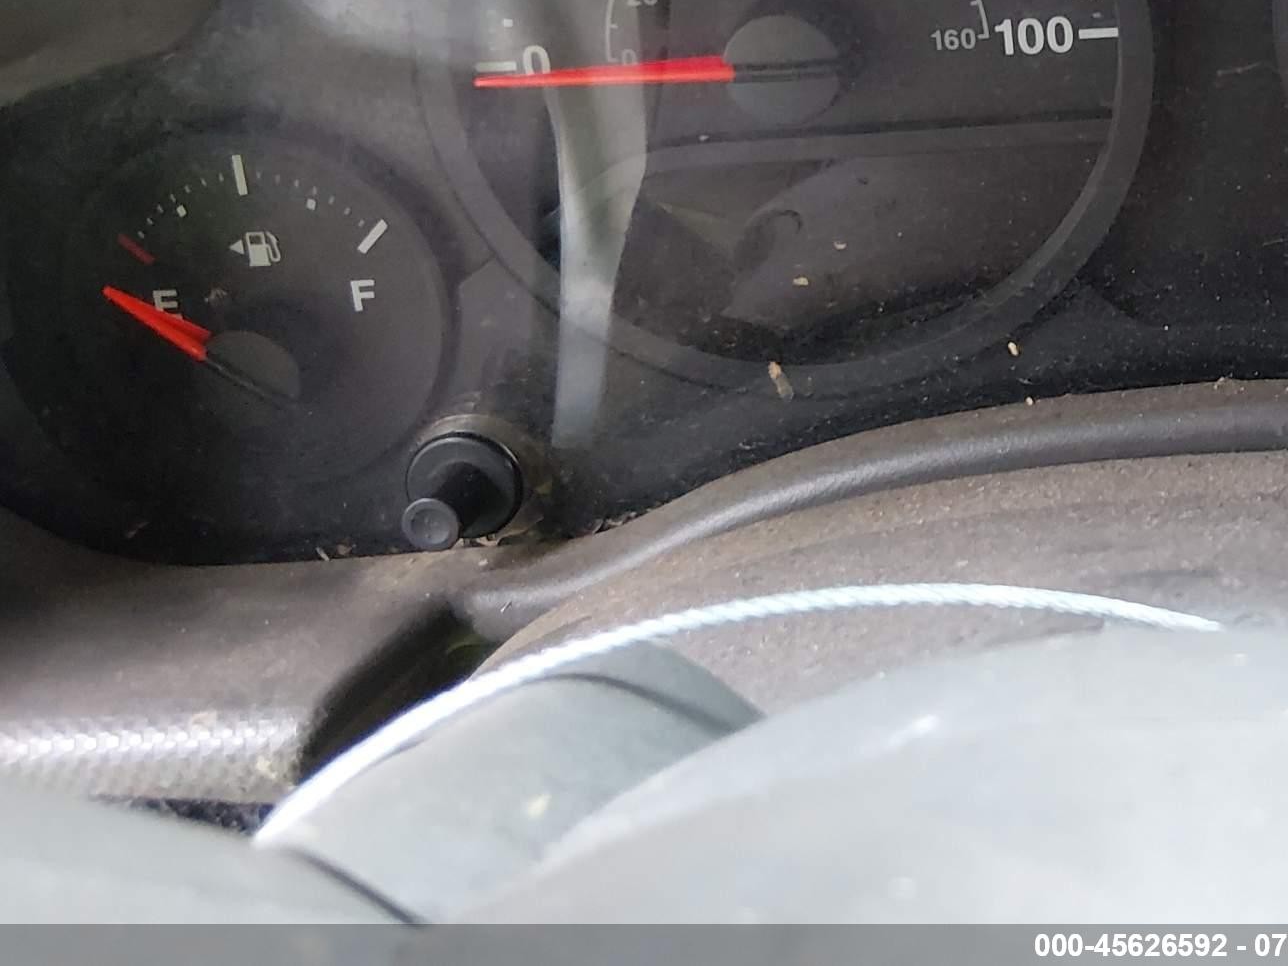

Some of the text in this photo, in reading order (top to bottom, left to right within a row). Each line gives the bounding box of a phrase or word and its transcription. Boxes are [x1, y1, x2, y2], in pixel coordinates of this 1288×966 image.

[931, 28, 977, 51] 160
[994, 16, 1074, 55] 100
[521, 44, 551, 75] 0
[152, 289, 182, 319] E
[350, 279, 376, 312] F
